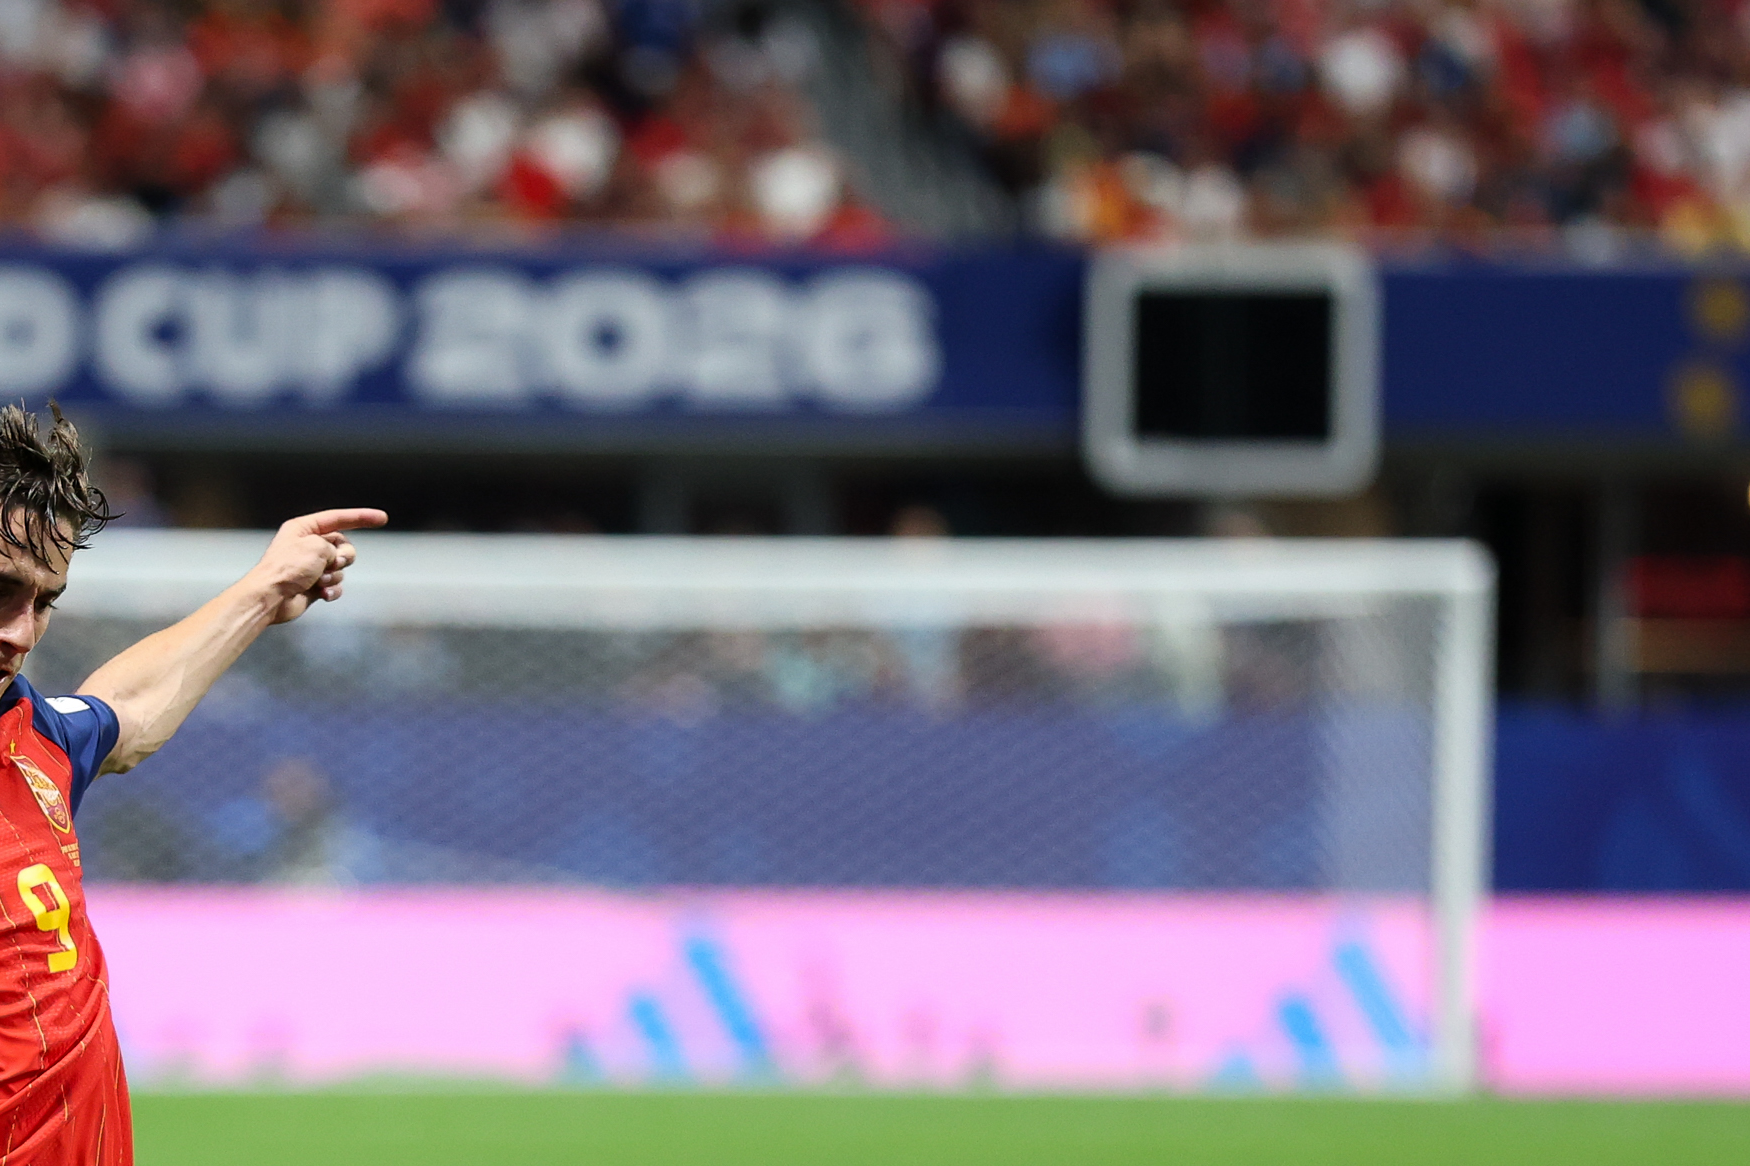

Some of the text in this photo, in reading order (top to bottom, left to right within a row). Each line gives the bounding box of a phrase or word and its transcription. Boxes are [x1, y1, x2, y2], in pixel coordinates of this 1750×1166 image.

[92, 265, 398, 408] CUP
[408, 266, 938, 411] 2026
[17, 863, 78, 973] 9
